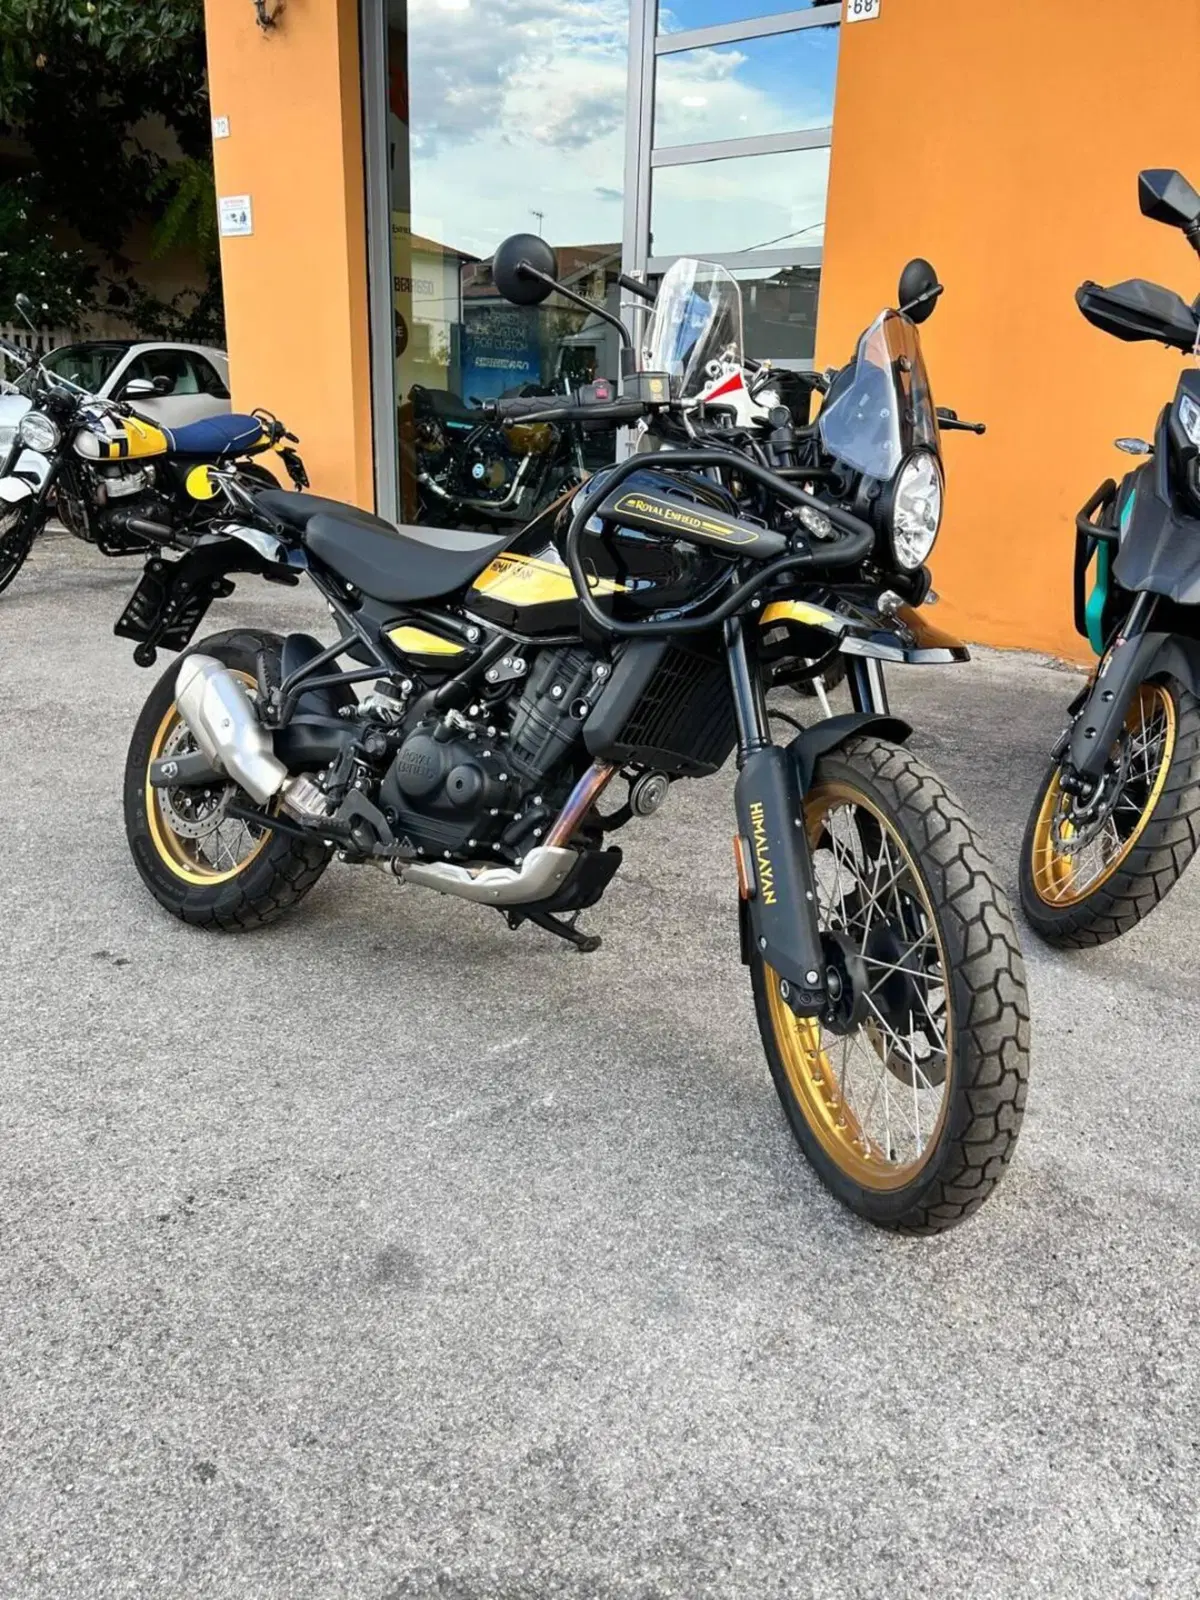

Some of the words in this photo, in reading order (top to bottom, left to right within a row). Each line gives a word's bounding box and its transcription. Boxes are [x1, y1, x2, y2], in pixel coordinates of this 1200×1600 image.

[854, 0, 873, 14] 68
[635, 499, 664, 518] ROYAL
[664, 508, 701, 528] ENFIELD
[750, 802, 777, 905] HIMALAYAN
